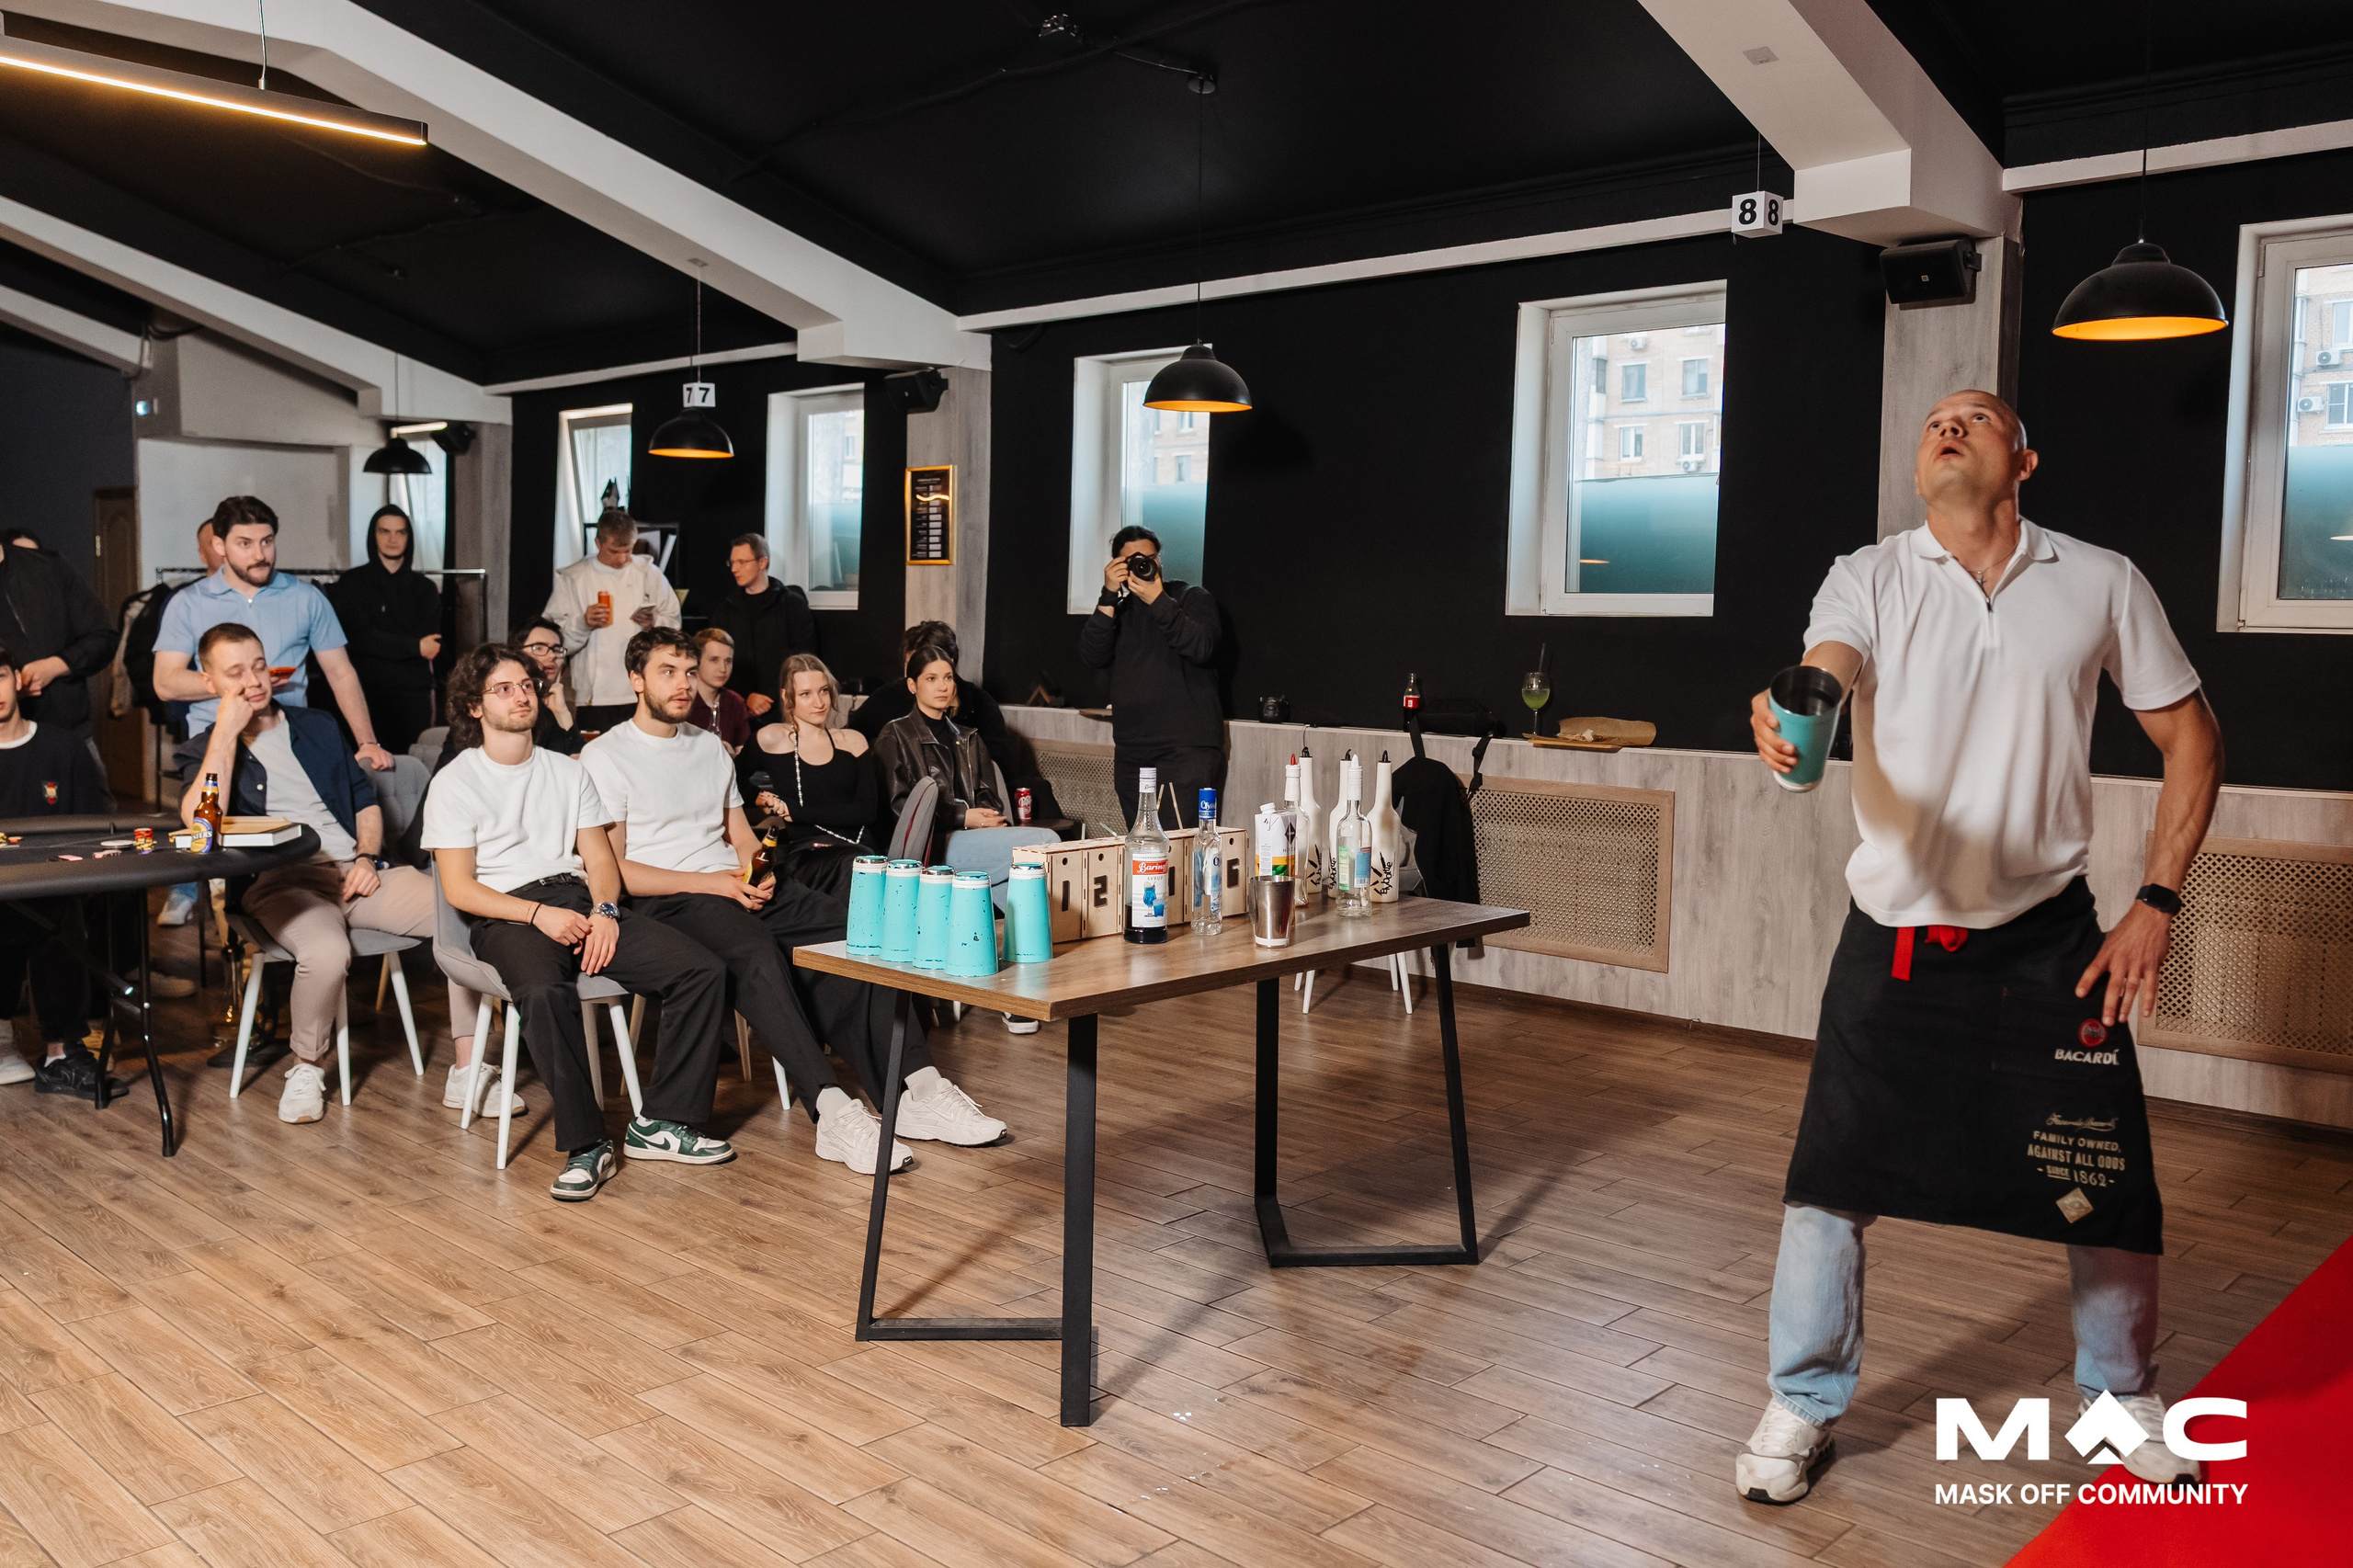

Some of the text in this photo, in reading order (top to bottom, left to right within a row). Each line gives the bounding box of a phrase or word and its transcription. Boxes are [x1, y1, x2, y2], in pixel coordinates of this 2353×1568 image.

[1739, 199, 1756, 225] 8
[1768, 199, 1779, 225] 8
[687, 387, 693, 403] 7
[699, 387, 710, 403] 7
[1094, 875, 1108, 908] 2
[2033, 1131, 2075, 1145] FAMILY
[2027, 1143, 2125, 1171] AGAINST ALL ODDS
[2046, 1165, 2070, 1177] SINCE
